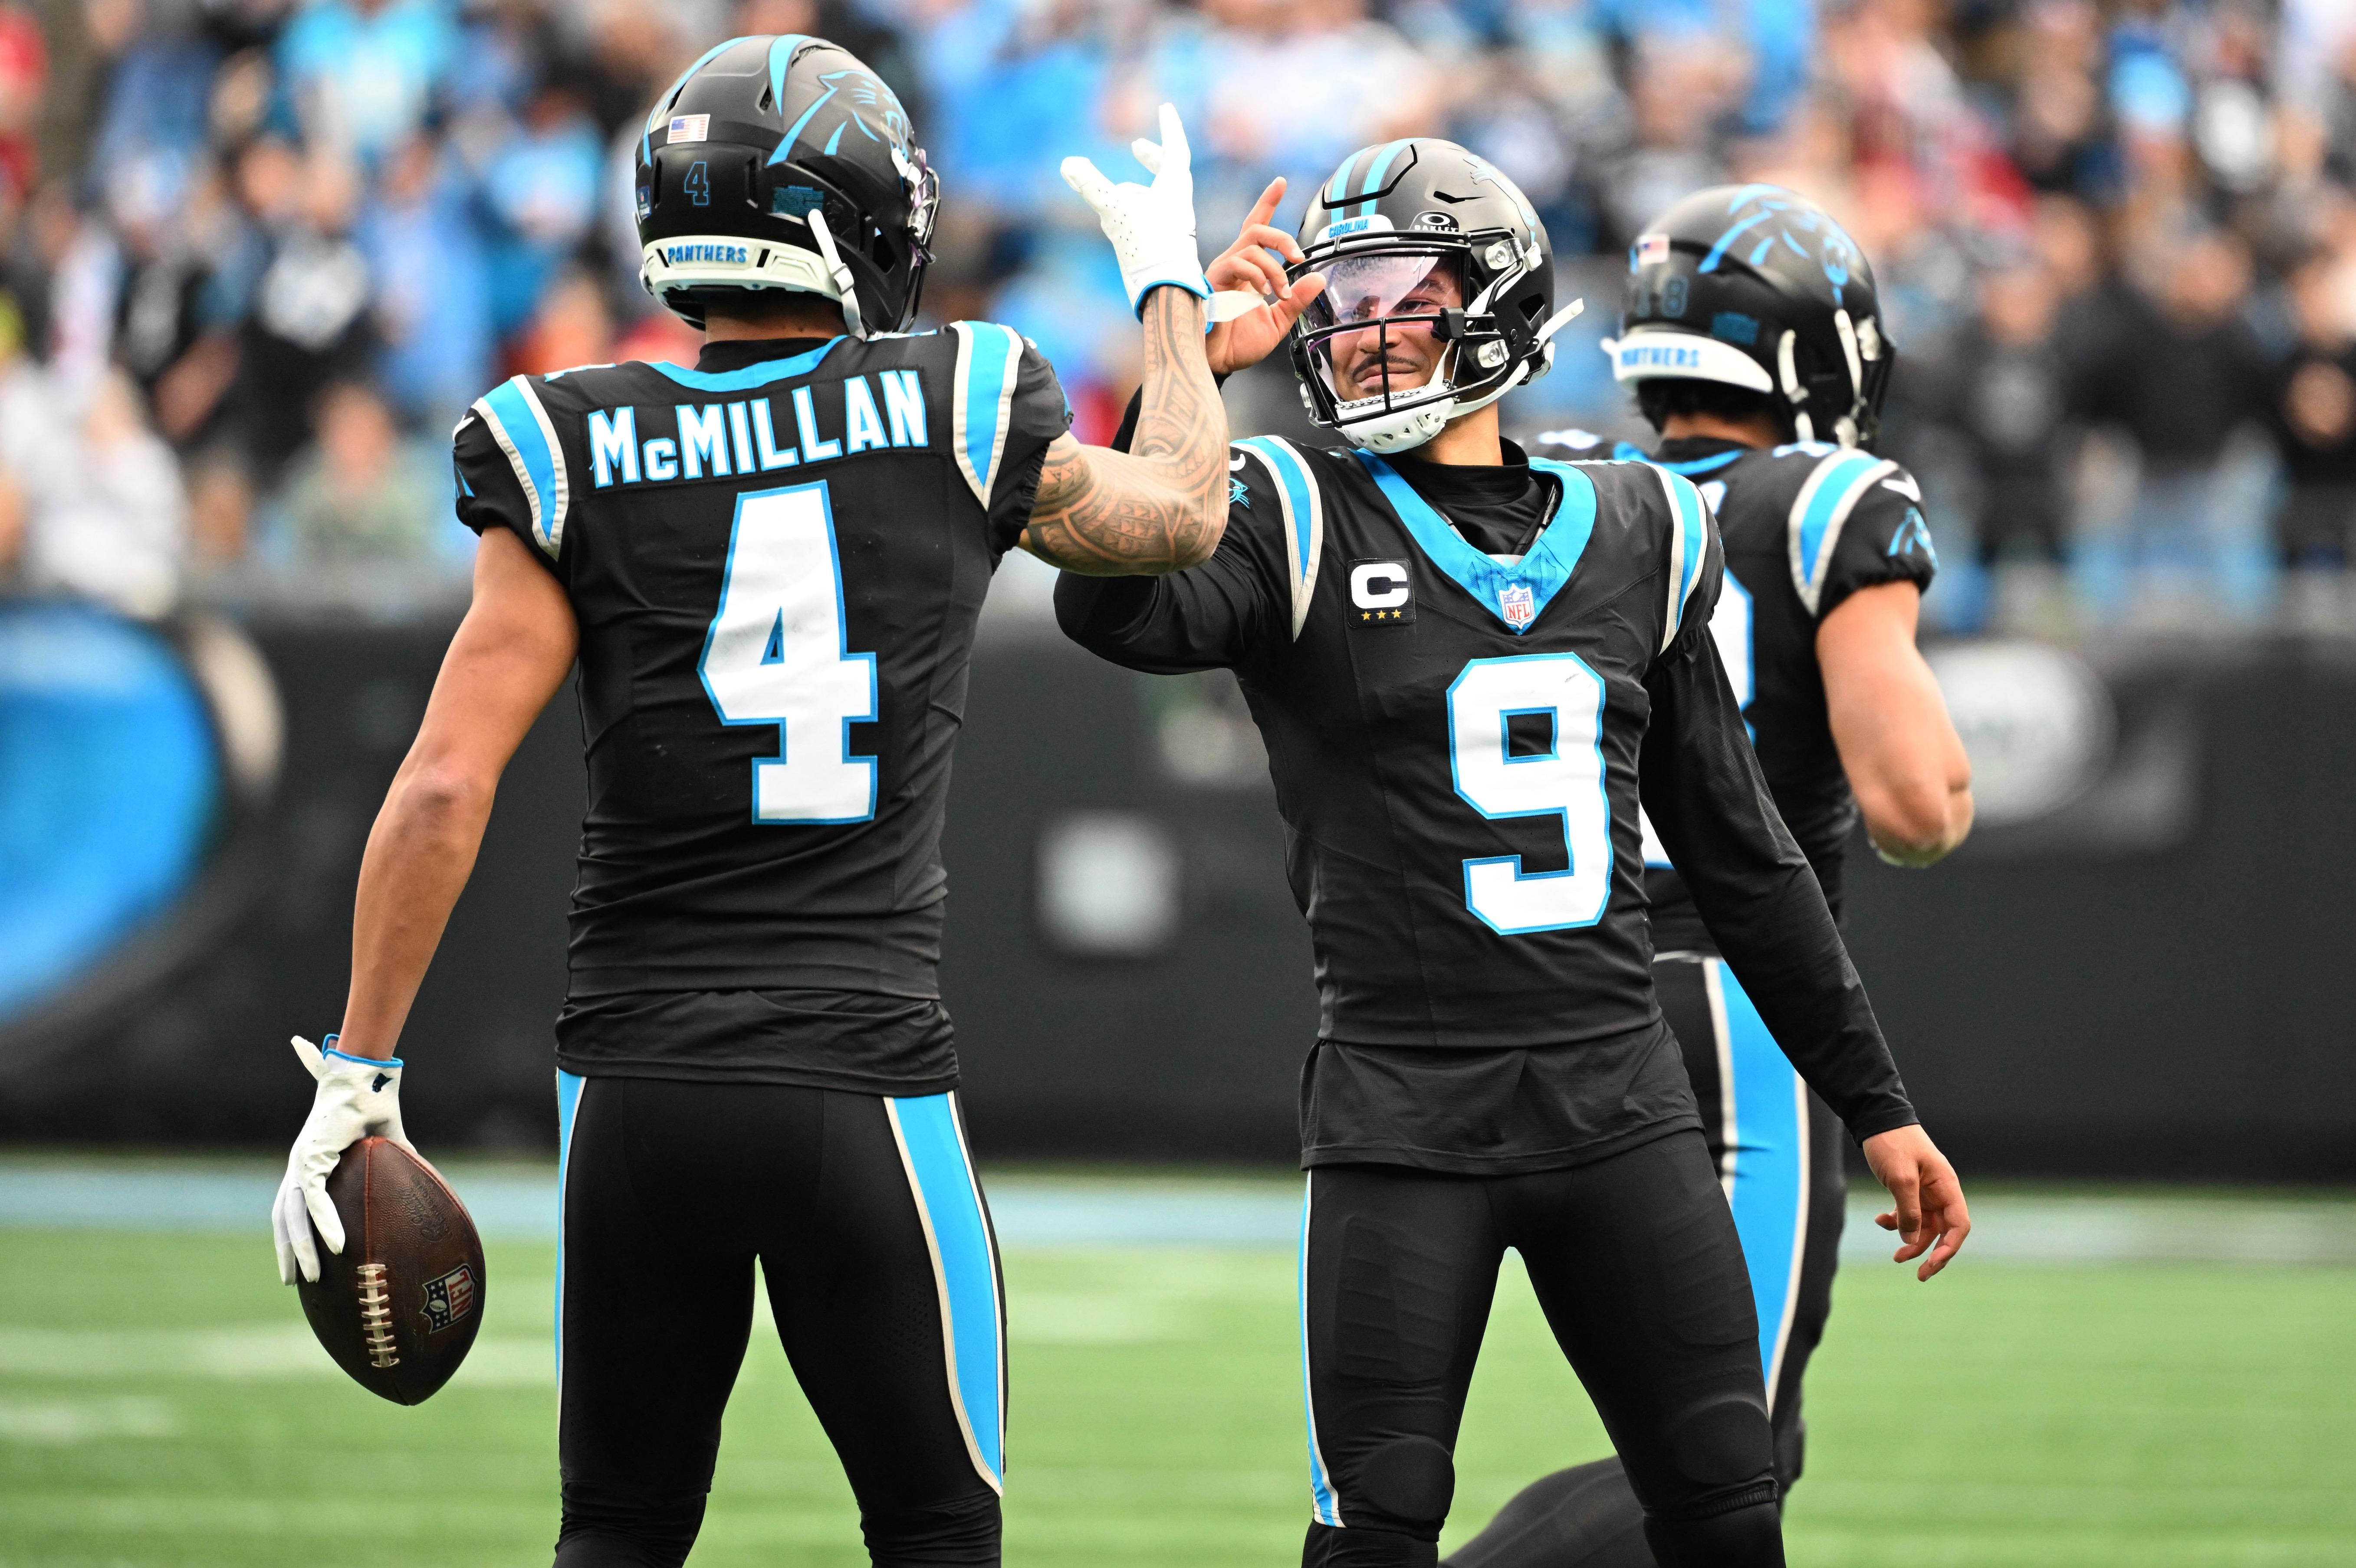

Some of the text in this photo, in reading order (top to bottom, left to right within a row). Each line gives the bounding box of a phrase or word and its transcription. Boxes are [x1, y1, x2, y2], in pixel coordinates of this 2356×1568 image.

[684, 161, 709, 205] 4
[1328, 219, 1369, 238] CAROLINA
[667, 244, 747, 263] PANTHERS
[588, 370, 928, 488] McMILLAN
[1351, 563, 1409, 609] C
[1507, 604, 1530, 620] NFL
[697, 479, 878, 825] 4
[1446, 652, 1613, 935] 9
[448, 1270, 473, 1319] NFL
